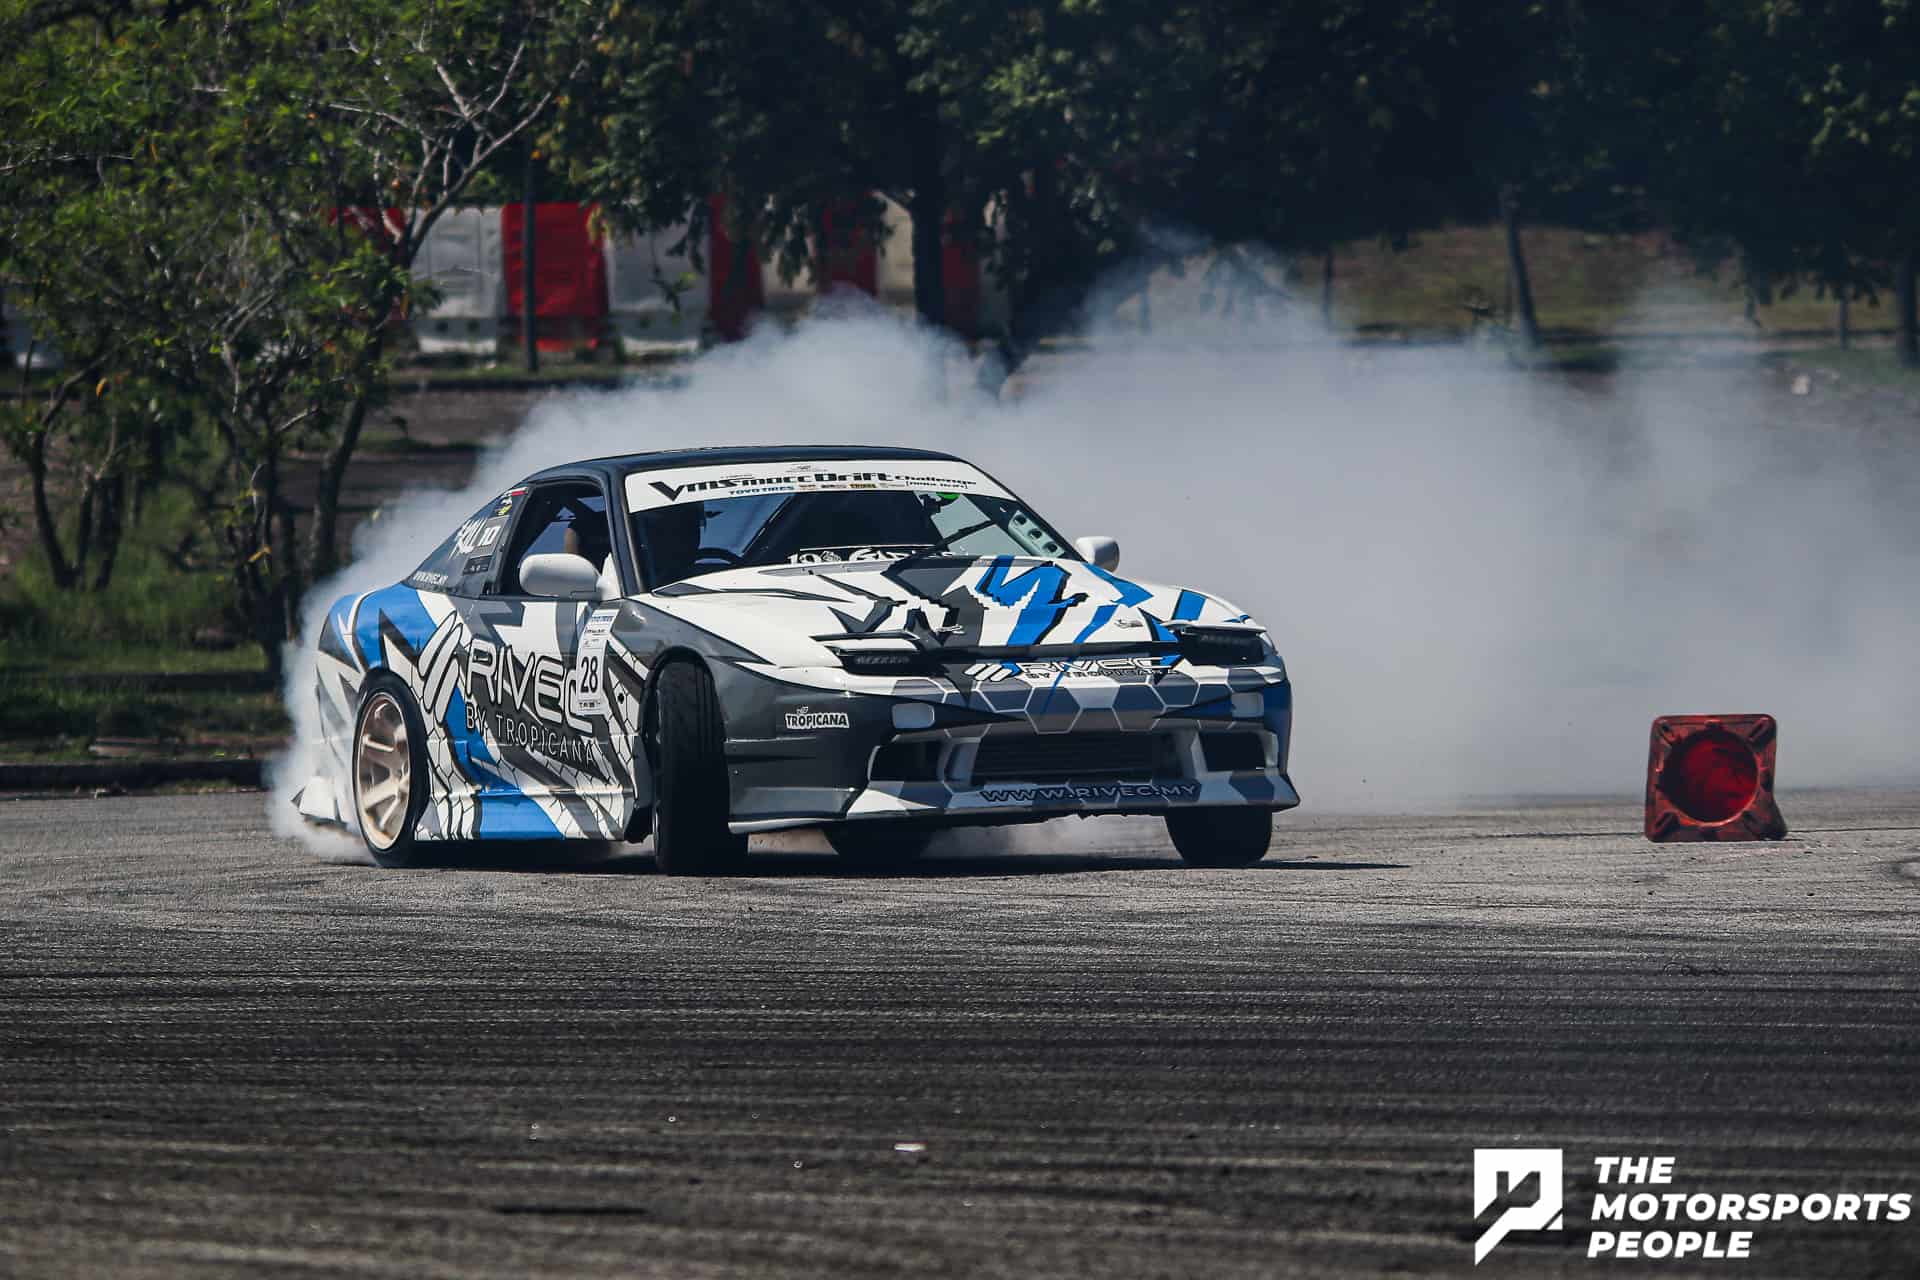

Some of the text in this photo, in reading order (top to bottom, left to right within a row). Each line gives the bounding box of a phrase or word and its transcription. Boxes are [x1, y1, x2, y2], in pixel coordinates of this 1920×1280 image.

[580, 656, 599, 693] 28
[466, 701, 596, 762] BY TROPICANA
[785, 713, 849, 728] TROPICANA
[979, 784, 1196, 801] WWW.RIVEC.MY
